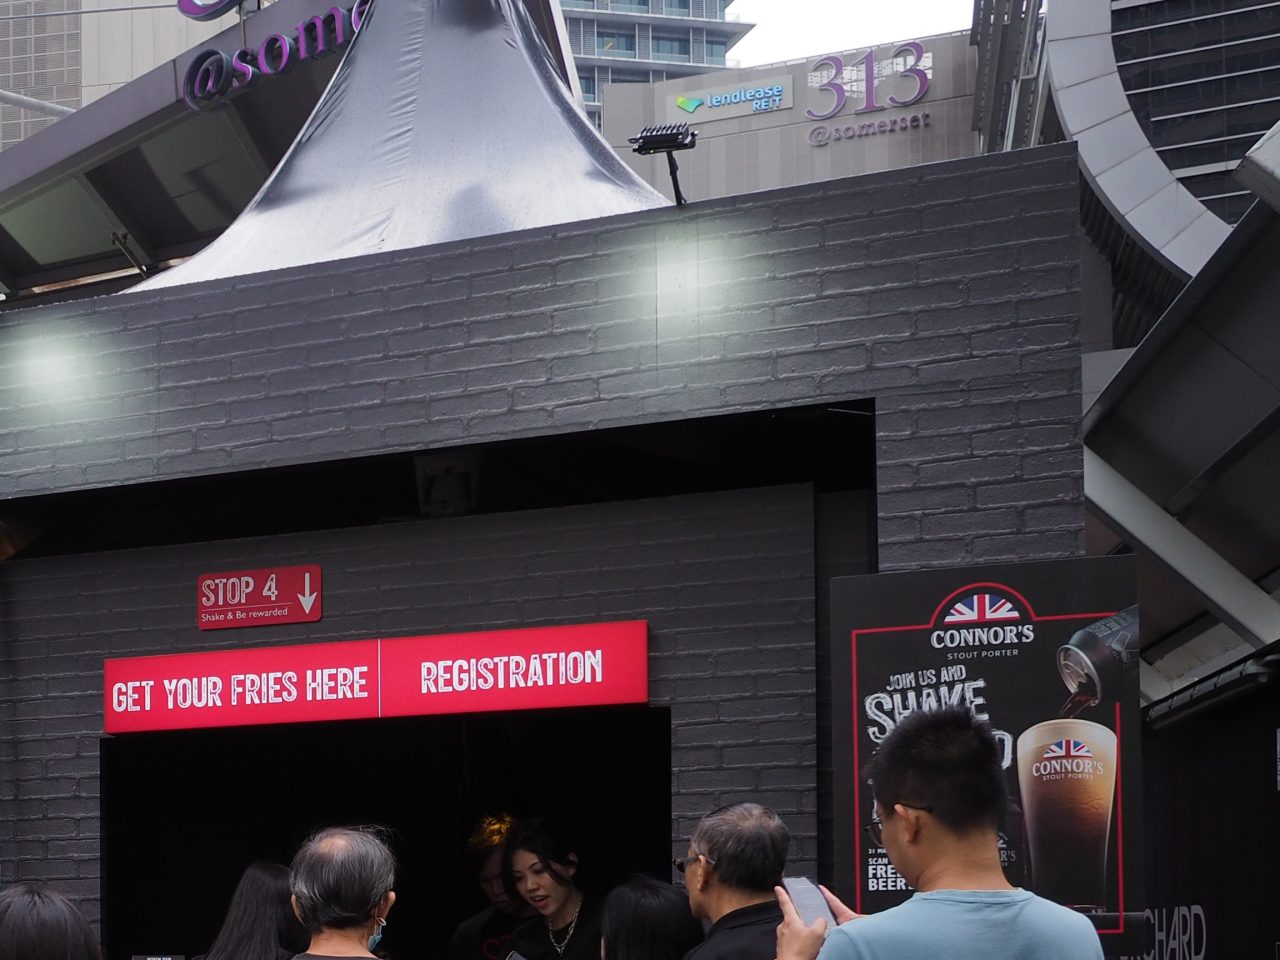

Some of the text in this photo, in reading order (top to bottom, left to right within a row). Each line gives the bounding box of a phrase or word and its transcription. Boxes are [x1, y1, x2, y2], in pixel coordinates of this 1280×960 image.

[805, 40, 929, 120] 313
[707, 83, 783, 108] lendlease
[752, 96, 782, 112] REIT
[808, 111, 930, 147] @somerset
[201, 574, 278, 606] STOP 4
[201, 608, 288, 622] Shake & Be rewarded
[930, 624, 1034, 648] CONNOR'S
[947, 649, 1018, 660] STOUT PORTER
[420, 649, 603, 694] REGISTRATION
[886, 664, 966, 691] JOIN US AND
[112, 666, 369, 713] GET YOUR FRIES HERE
[1032, 759, 1104, 776] CONNOR'S
[1042, 774, 1065, 782] STOUT
